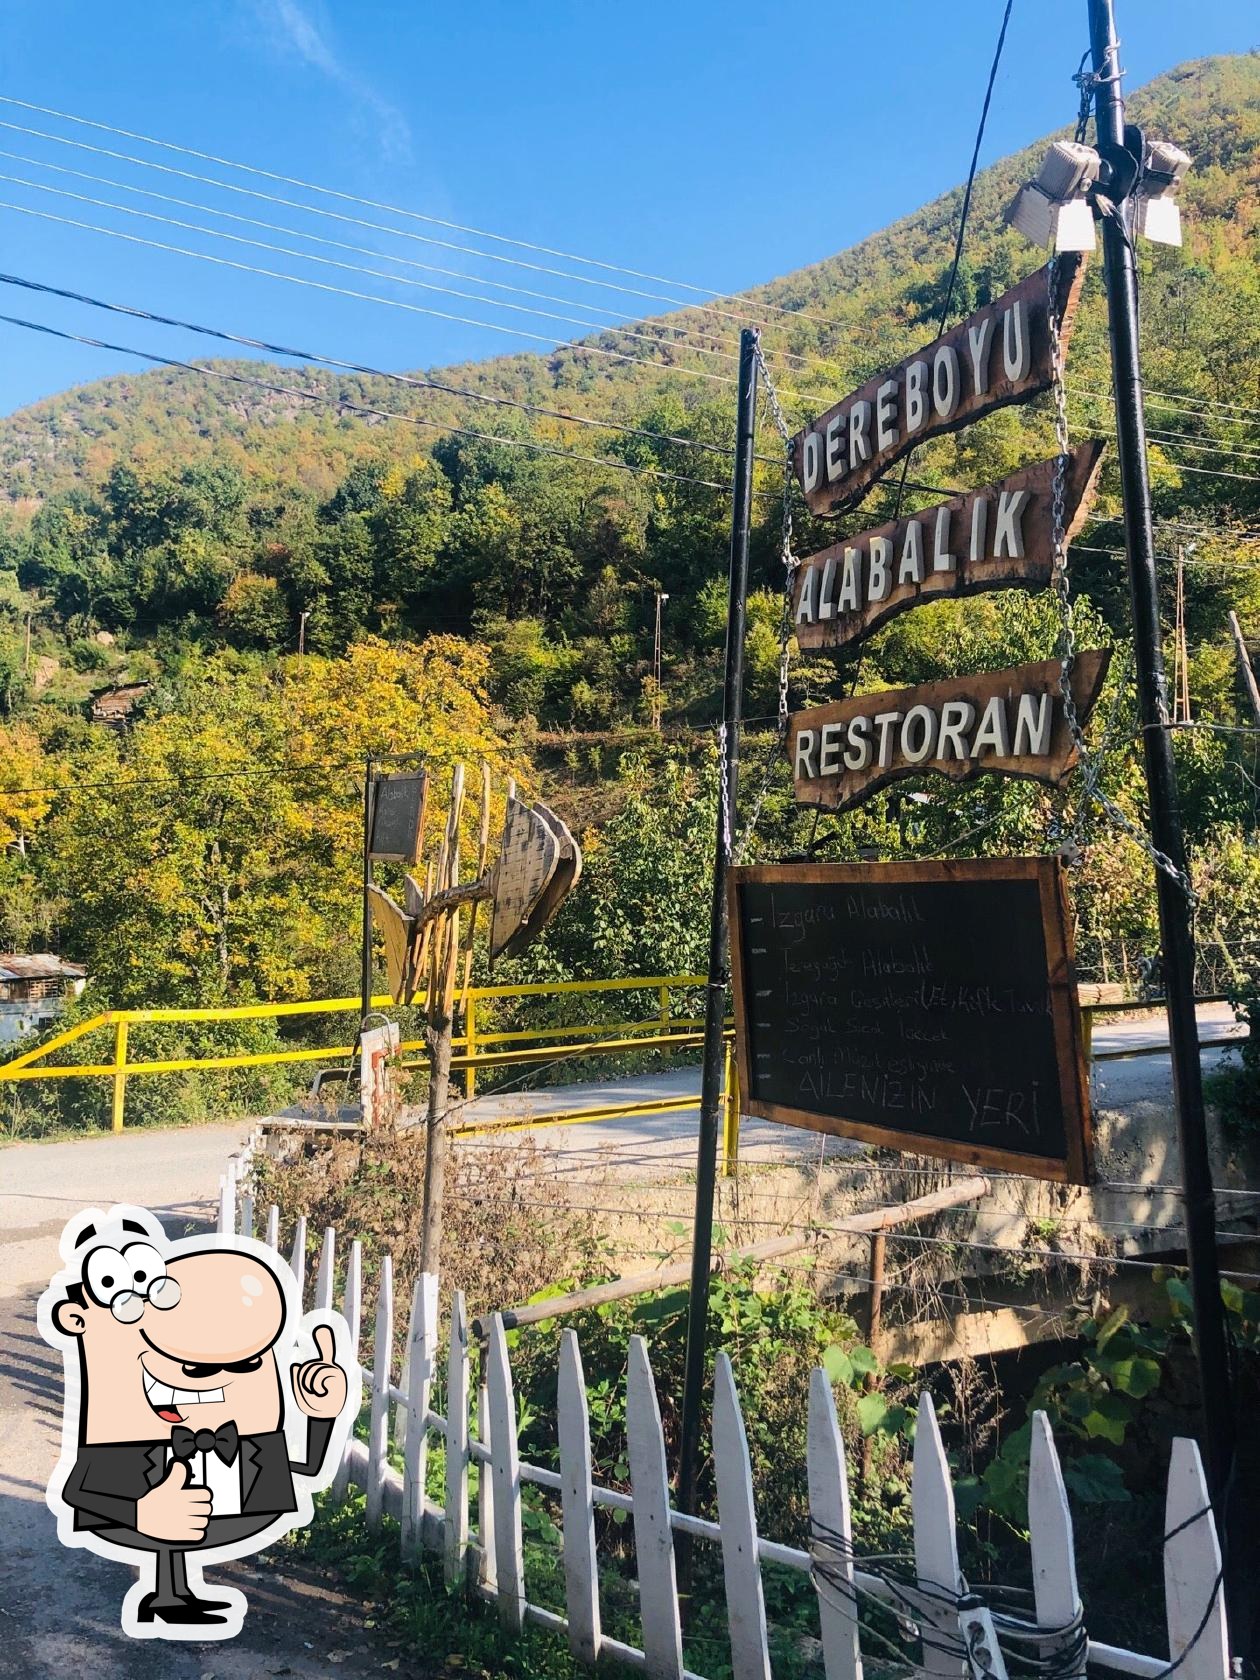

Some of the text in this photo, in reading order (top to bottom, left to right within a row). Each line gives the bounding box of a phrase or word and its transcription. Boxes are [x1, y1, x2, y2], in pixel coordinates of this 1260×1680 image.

[802, 300, 1032, 494] DEREBOYU
[795, 489, 1031, 625] ALABALIK
[794, 692, 1053, 779] RESTORAN
